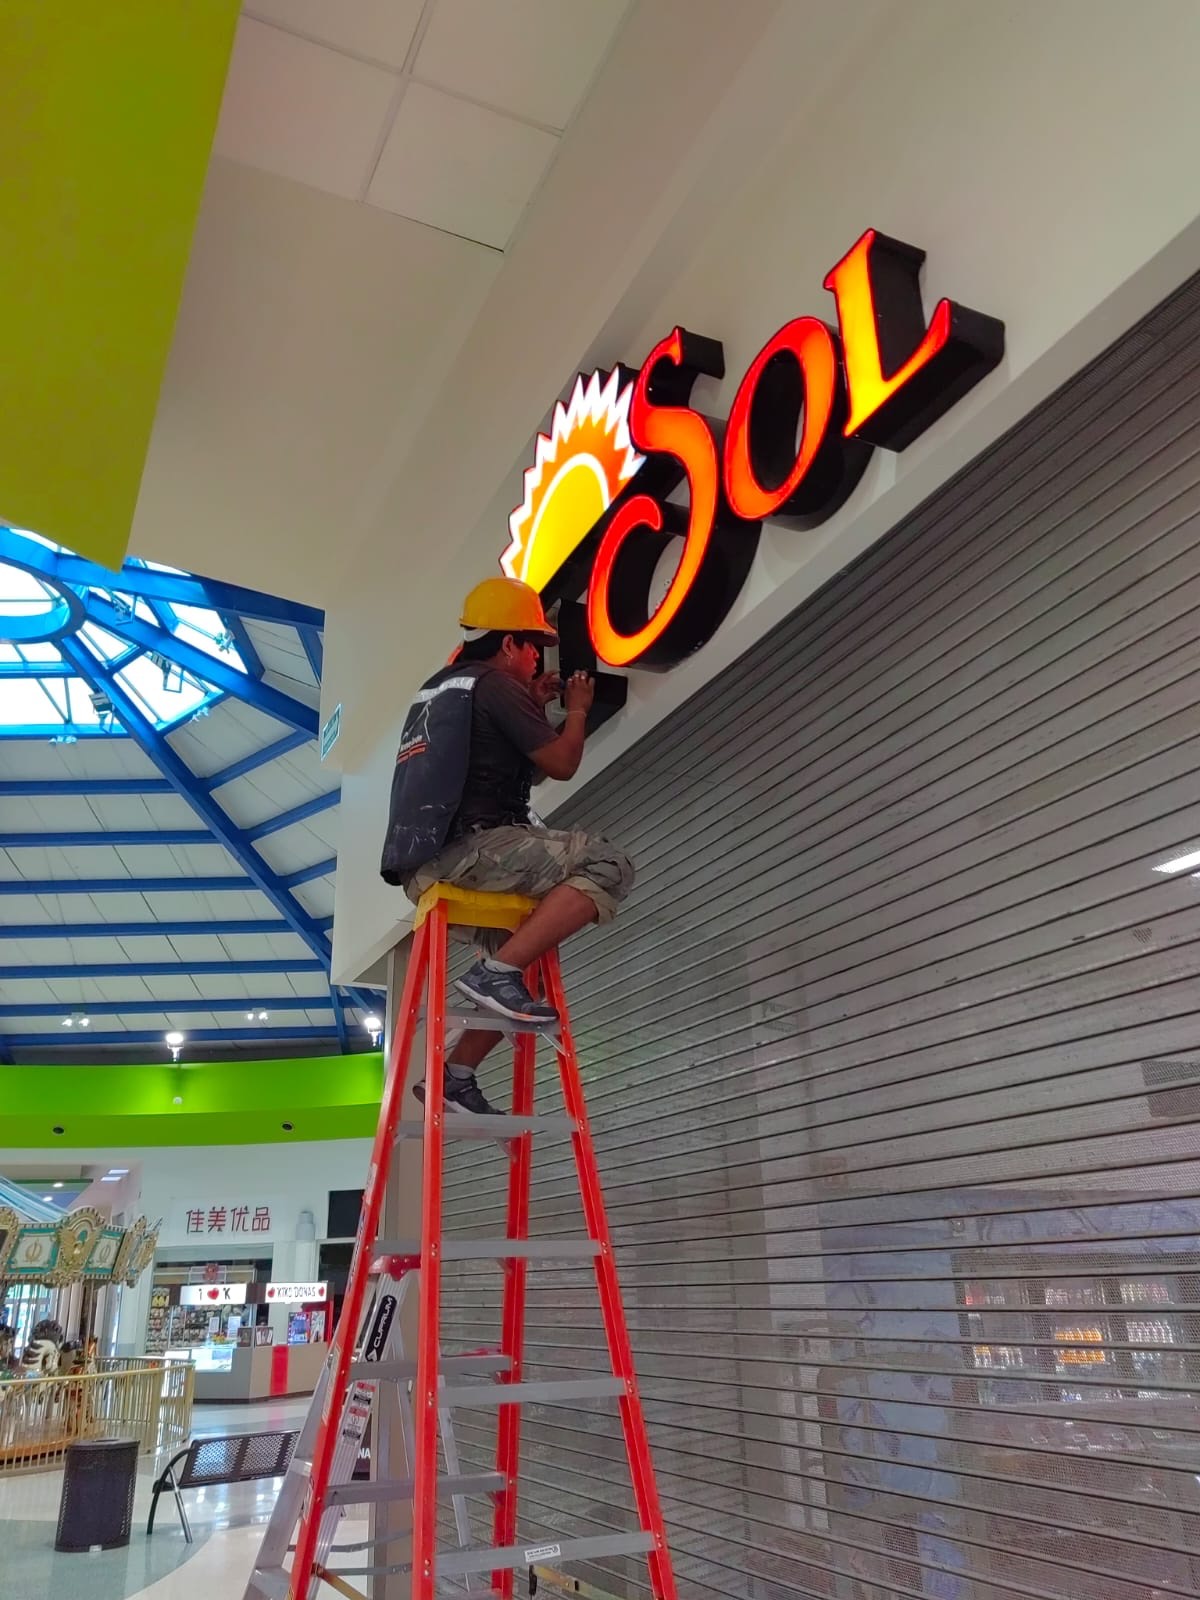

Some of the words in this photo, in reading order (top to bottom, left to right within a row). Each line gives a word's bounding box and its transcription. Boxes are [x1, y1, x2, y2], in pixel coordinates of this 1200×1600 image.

[587, 228, 952, 667] SOL
[186, 1206, 271, 1234] 佳美优品
[222, 1287, 231, 1300] K
[373, 1297, 393, 1348] CUPRUM
